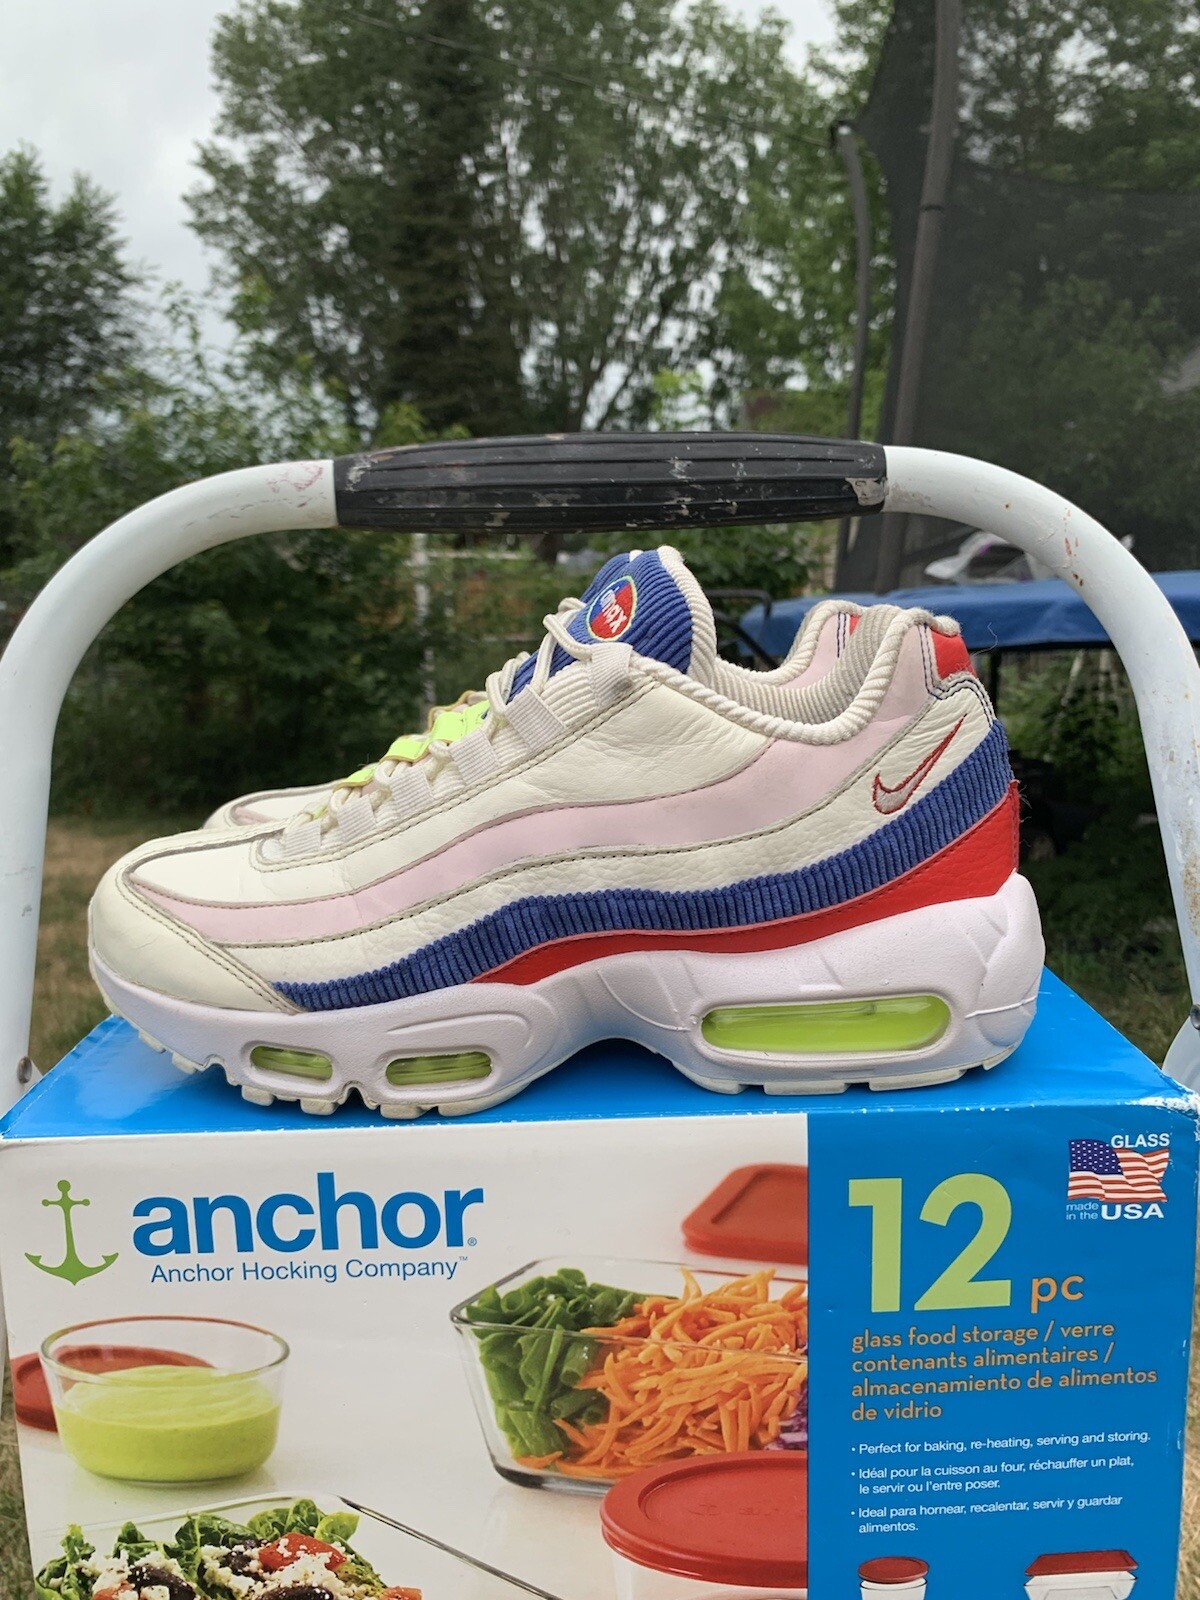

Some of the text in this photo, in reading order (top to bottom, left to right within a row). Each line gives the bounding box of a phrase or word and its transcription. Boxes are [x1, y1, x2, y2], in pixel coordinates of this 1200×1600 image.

[1110, 1133, 1170, 1148] GLASS
[132, 1171, 484, 1257] anchor
[1066, 1202, 1099, 1211] made
[1066, 1211, 1099, 1220] in the
[1101, 1203, 1165, 1221] USA
[848, 1172, 1012, 1313] 12
[151, 1263, 234, 1283] Anchor
[242, 1260, 337, 1283] Hocking
[345, 1258, 458, 1281] Company
[1030, 1275, 1084, 1314] pc
[851, 1328, 902, 1353] glass
[908, 1324, 957, 1345] food
[962, 1325, 1039, 1346] storage
[1060, 1324, 1115, 1338] verre
[852, 1351, 968, 1373] contenants
[973, 1345, 1099, 1367] alimentaires
[851, 1366, 1157, 1397] almacenamiento de alimentos
[851, 1400, 942, 1421] de vidrio
[859, 1431, 1151, 1454] Perfect for baking, re-heating, serving and storing.
[859, 1455, 1135, 1480] Idéal pour la cuisson au four, réchauffer un plat,
[859, 1479, 1001, 1495] le servir ou l'entre poser.
[858, 1495, 1123, 1519] Ideal para hornear, recalentar, servir y guardar
[858, 1521, 919, 1534] alimentos.
